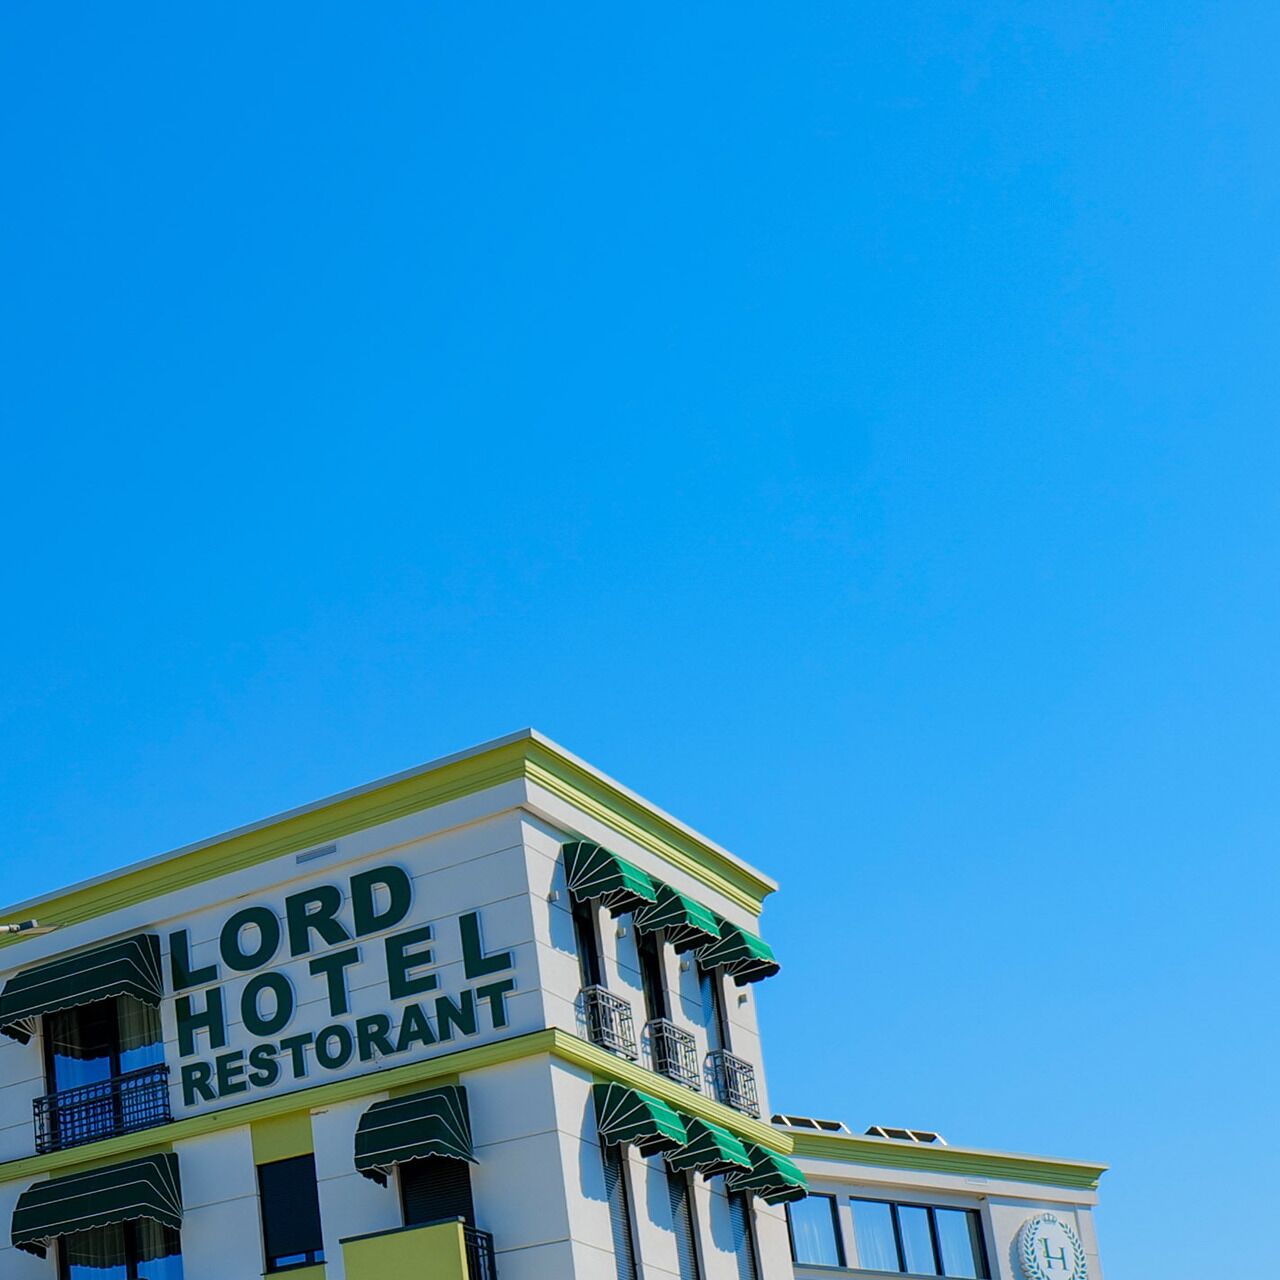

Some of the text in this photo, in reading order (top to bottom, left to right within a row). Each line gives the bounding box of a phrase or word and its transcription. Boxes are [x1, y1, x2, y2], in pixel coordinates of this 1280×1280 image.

[168, 865, 413, 992] LORD
[174, 911, 513, 1058] HOTEL
[180, 978, 515, 1107] RESTORANT
